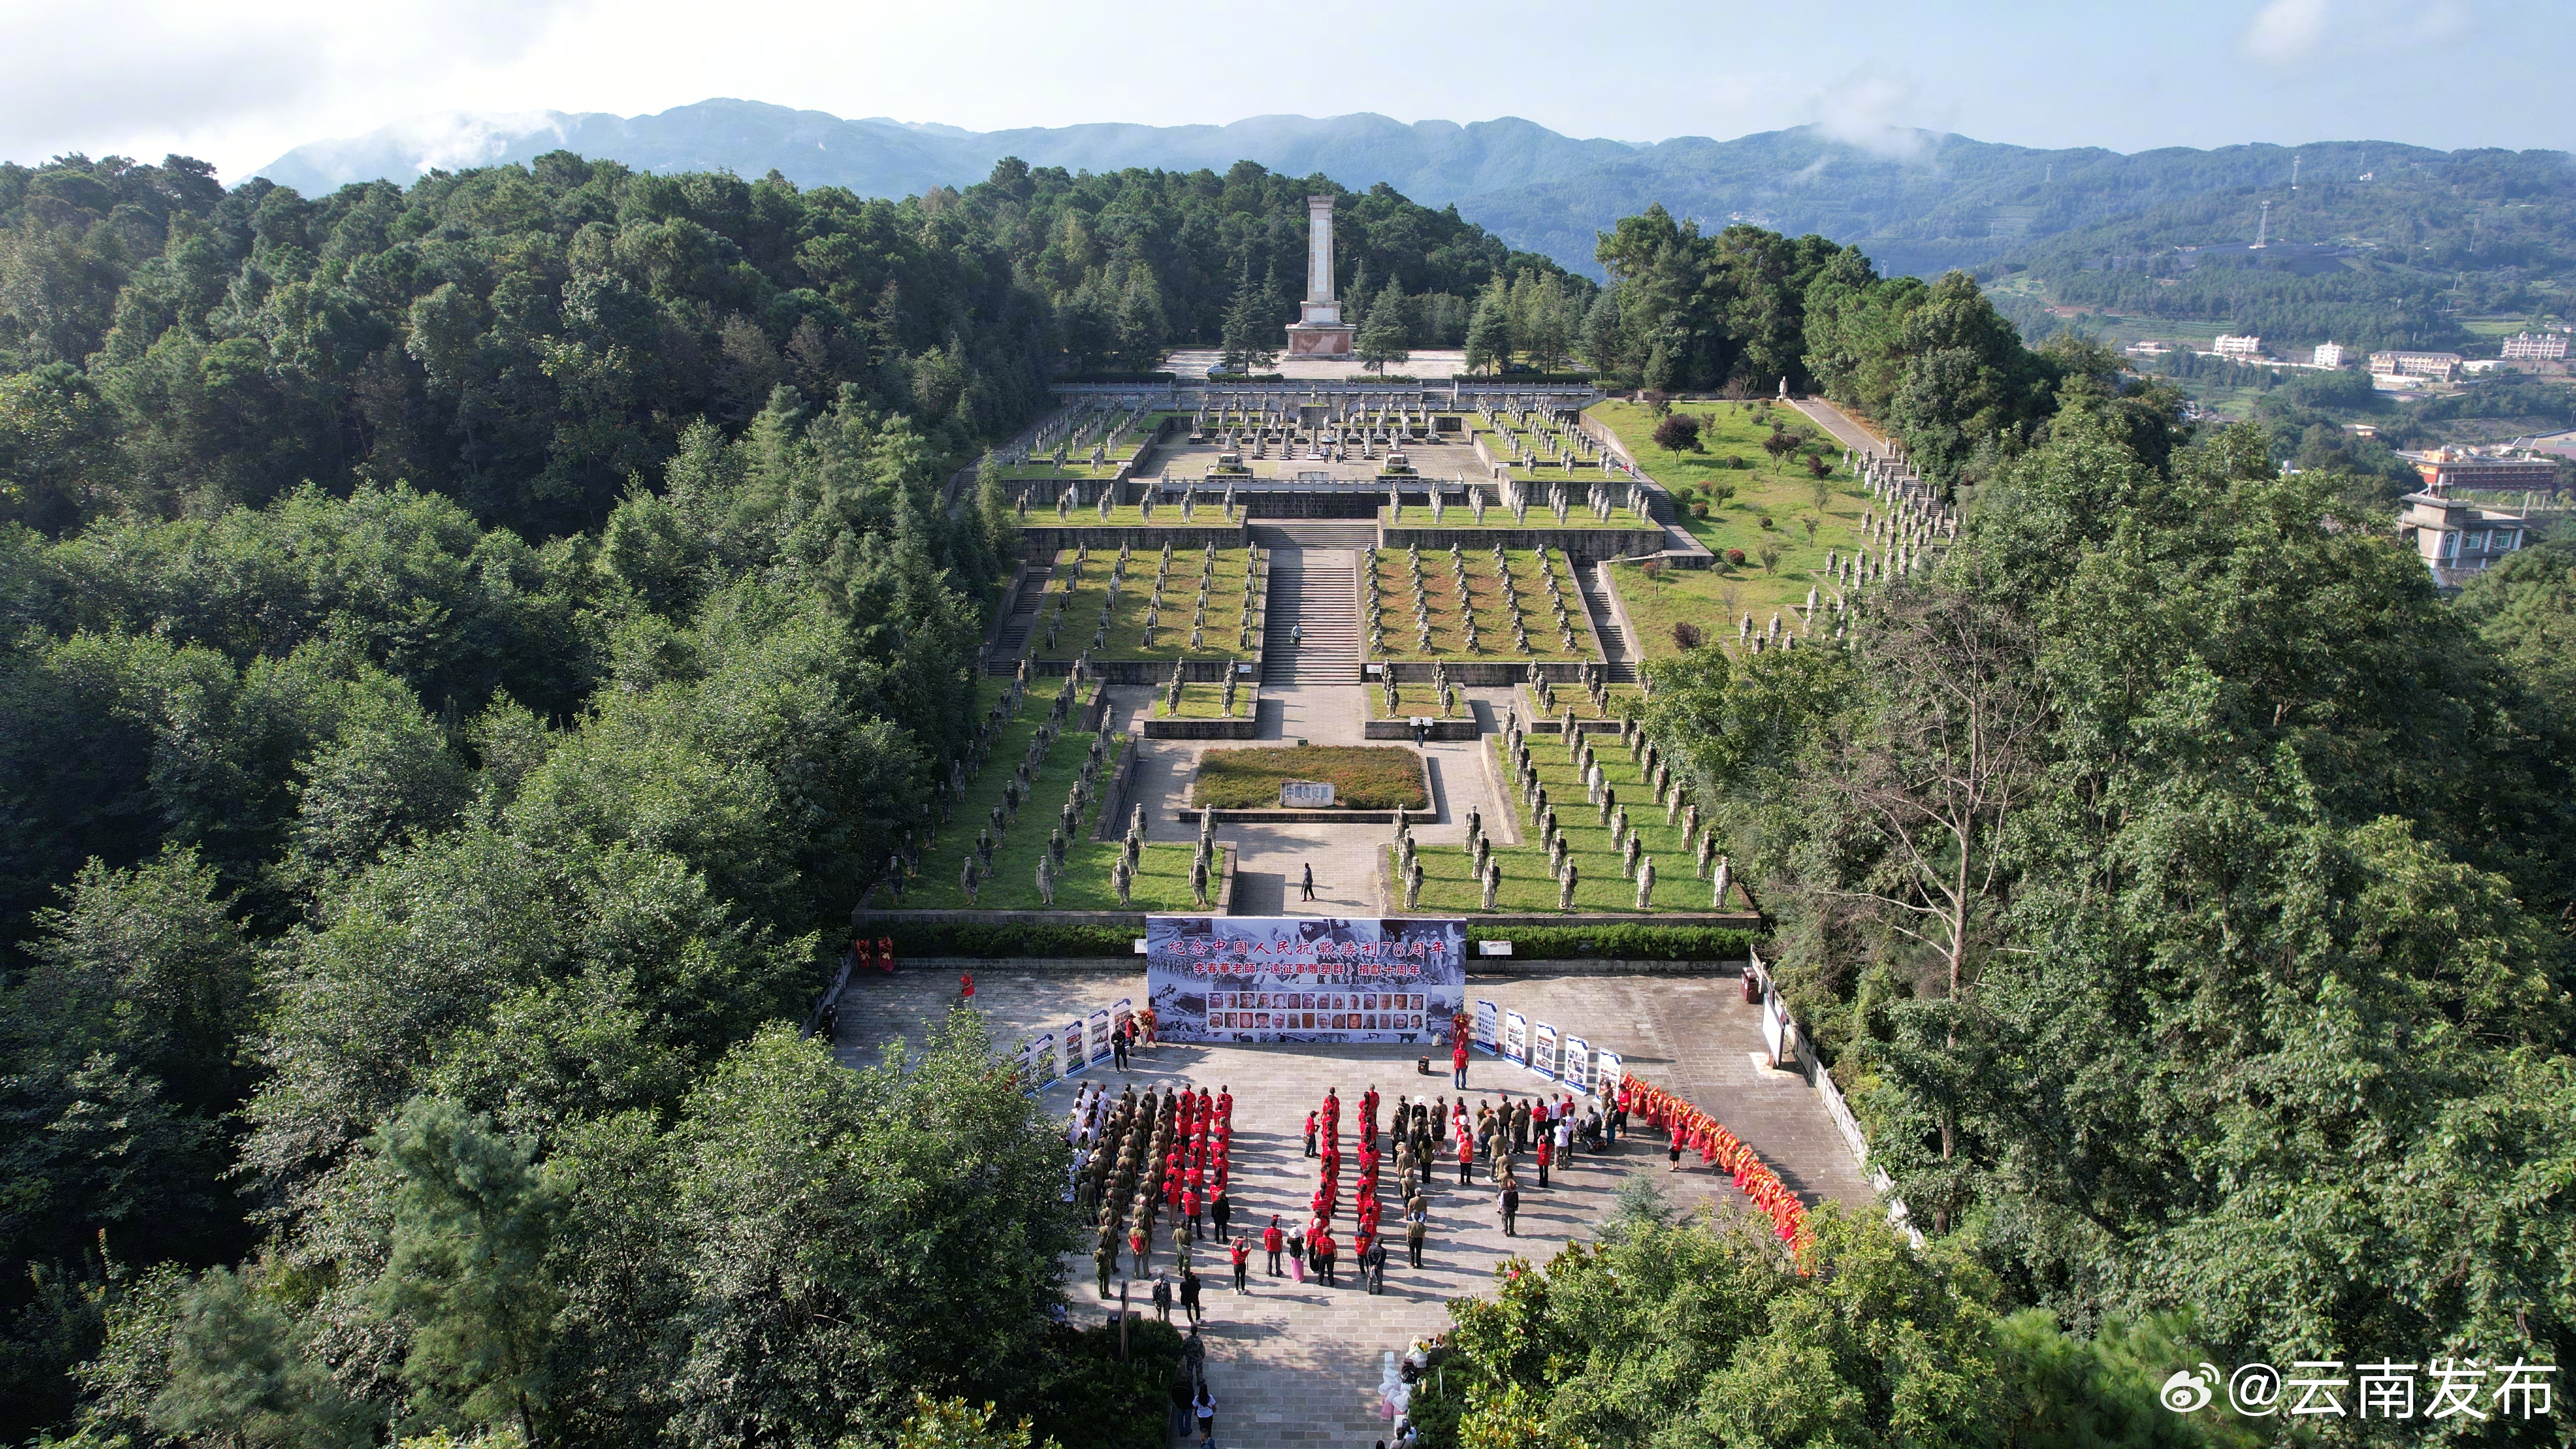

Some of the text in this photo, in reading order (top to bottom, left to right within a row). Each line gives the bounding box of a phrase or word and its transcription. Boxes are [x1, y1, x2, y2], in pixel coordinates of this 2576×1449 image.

[1168, 938, 1447, 958] 紀念中國人民抗戰勝利78周年
[1193, 962, 1421, 976] 李春華老師《遠征軍雕塑群》捐獻十周年
